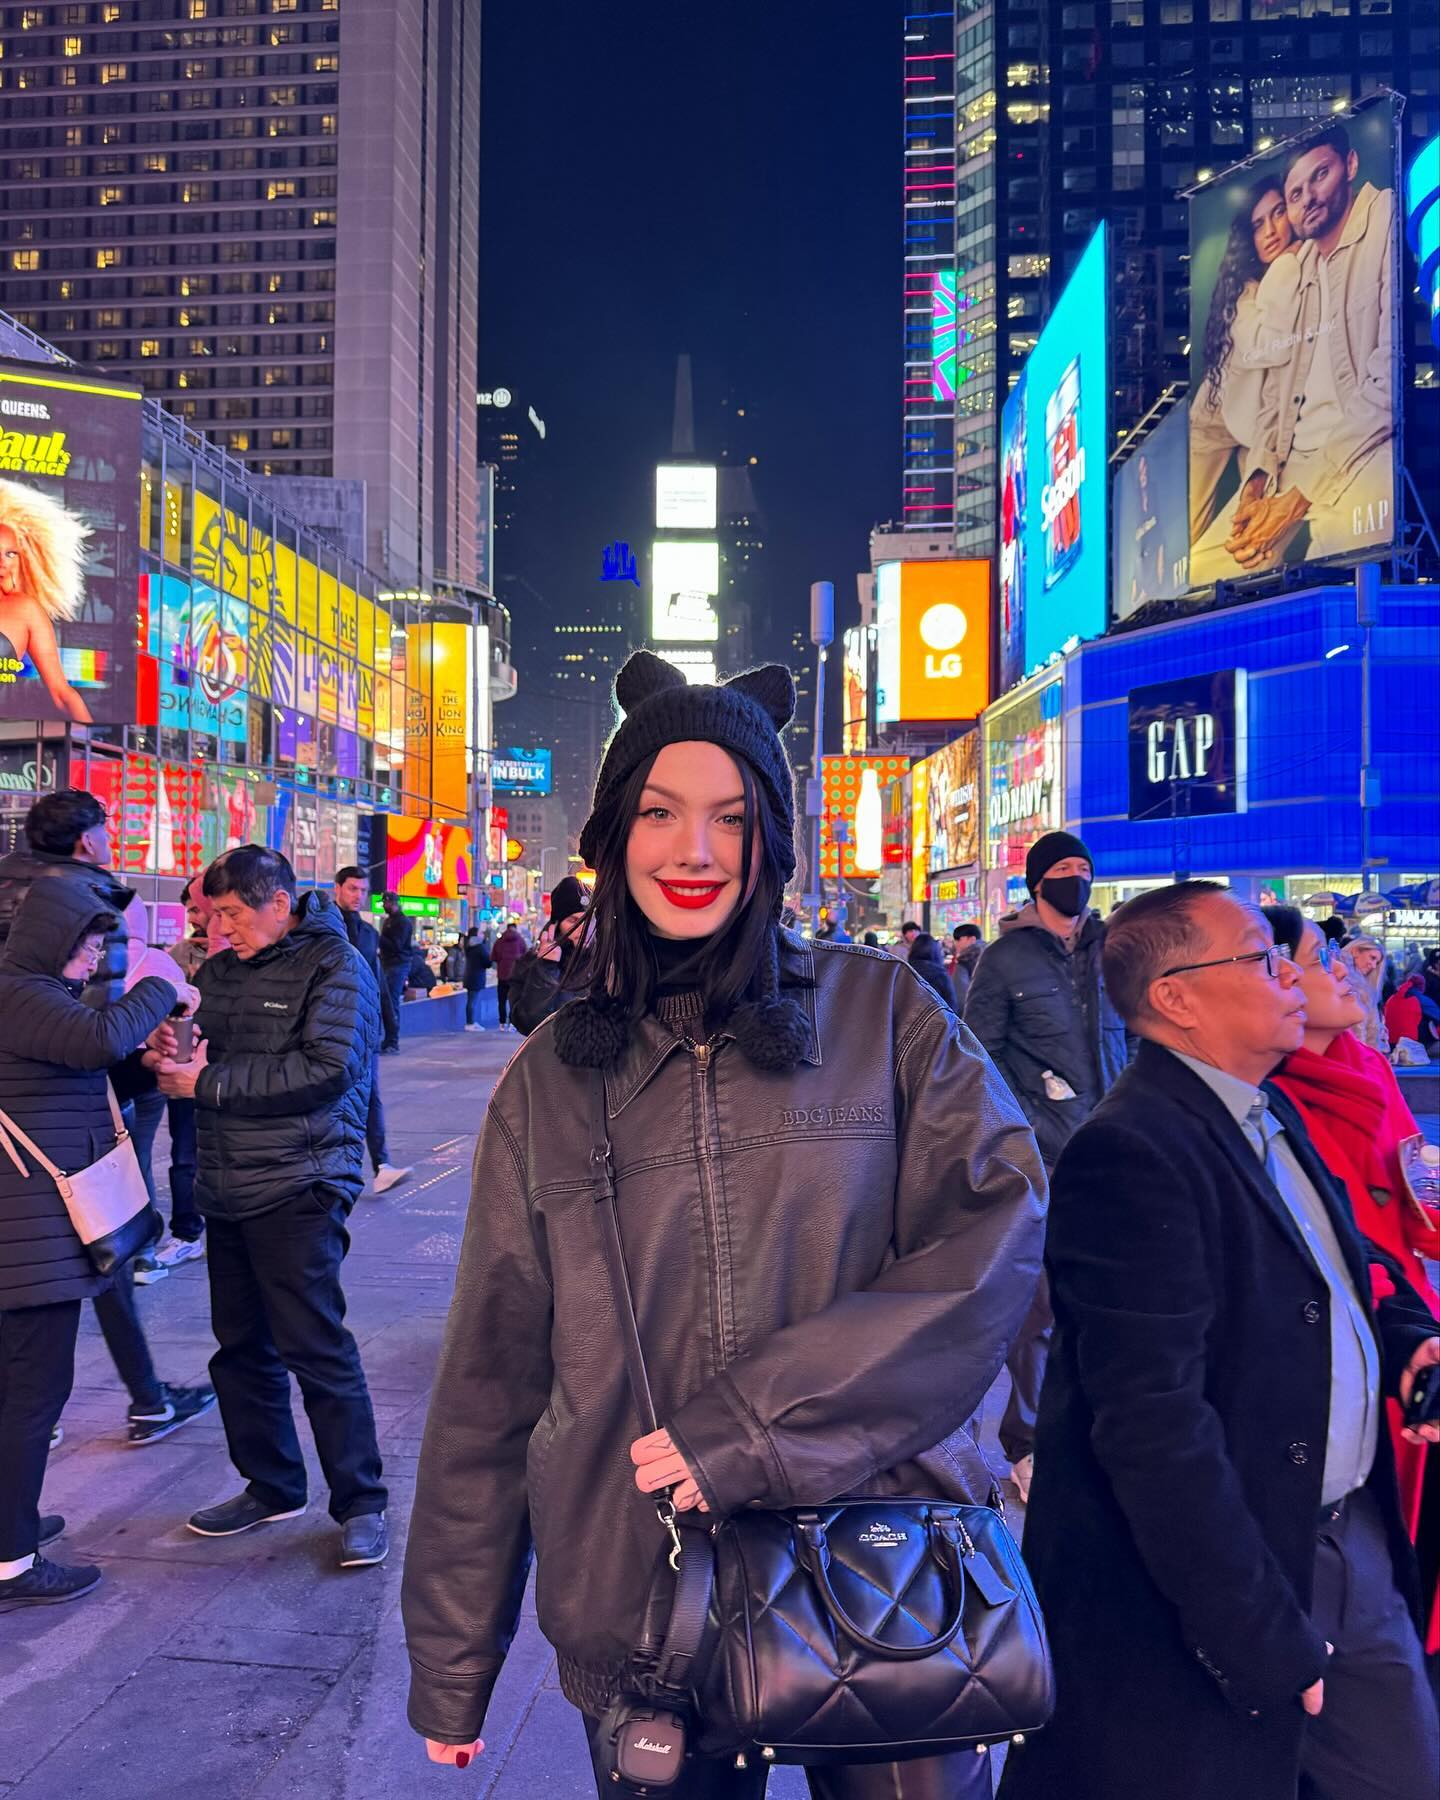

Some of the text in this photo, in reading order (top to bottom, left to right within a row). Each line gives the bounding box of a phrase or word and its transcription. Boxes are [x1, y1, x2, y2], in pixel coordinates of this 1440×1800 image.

[1, 399, 51, 420] QUEENS.
[0, 426, 72, 465] aul's
[25, 459, 68, 477] RACE
[1353, 499, 1389, 536] GAP
[331, 605, 357, 642] THE
[925, 653, 963, 679] LG
[346, 651, 375, 711] KIN
[441, 695, 459, 704] THE
[438, 706, 462, 721] LION
[436, 722, 465, 737] KING
[1148, 713, 1214, 784] GAP
[493, 766, 545, 780] IN BULK
[990, 778, 1043, 828] OLD NAVY
[783, 1106, 884, 1127] BDG JEANS
[859, 1532, 908, 1542] COACH
[634, 1737, 672, 1754] Marshall
